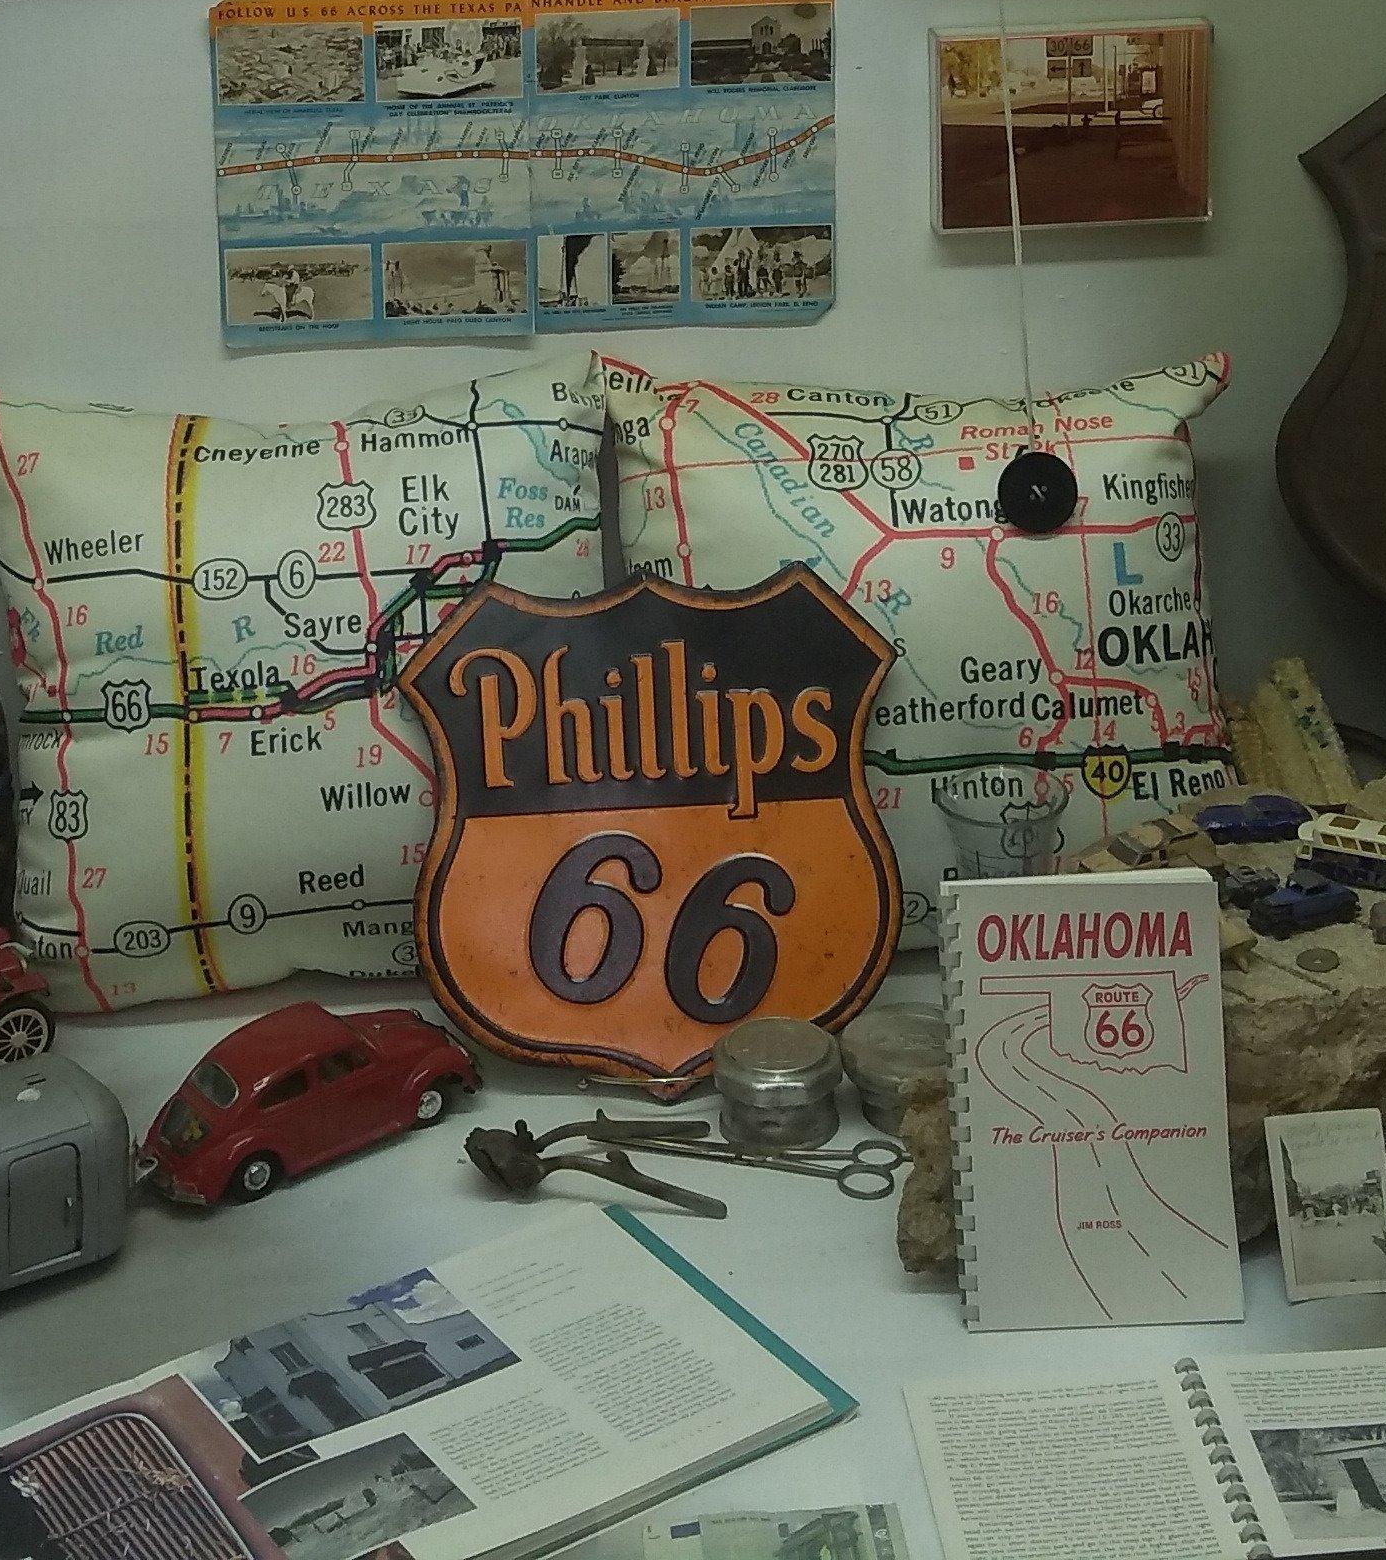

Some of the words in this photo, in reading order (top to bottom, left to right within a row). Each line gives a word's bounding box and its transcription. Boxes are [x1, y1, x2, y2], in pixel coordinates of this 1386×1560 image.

[218, 7, 275, 20] FOLLOW
[321, 6, 339, 17] 66
[347, 4, 405, 17] ACROSS
[413, 3, 441, 14] THE
[450, 2, 495, 14] TEXAS
[749, 391, 780, 404] 28
[786, 388, 889, 407] Canton
[927, 400, 955, 421] 51
[960, 422, 1044, 440] Roman
[1054, 414, 1114, 433] Nose
[17, 452, 41, 476] 27
[816, 443, 856, 463] 270
[734, 419, 836, 541] Canadian
[818, 463, 858, 483] 281
[877, 453, 914, 483] 58
[402, 474, 450, 503] Elk
[498, 476, 548, 500] Foss
[644, 487, 667, 511] 13
[327, 493, 367, 518] 283
[555, 495, 581, 512] DAM
[398, 507, 460, 540] City
[505, 507, 545, 529] Res
[44, 529, 144, 567] Wheeler
[1159, 524, 1181, 550] 33
[318, 542, 346, 564] 22
[406, 543, 431, 565] 17
[940, 546, 956, 569] 9
[1112, 541, 1145, 587] L
[201, 568, 239, 592] 152
[288, 564, 305, 589] 6
[863, 579, 891, 604] 13
[1032, 591, 1060, 615] 16
[1107, 586, 1192, 617] Okarche
[65, 605, 89, 627] 16
[232, 613, 257, 643] R
[283, 610, 362, 646] Sayre
[95, 624, 144, 655] Red
[190, 660, 282, 693] Texola
[291, 654, 316, 677] 16
[960, 655, 1043, 684] Geary
[112, 695, 142, 722] 66
[323, 709, 337, 731] 5
[874, 691, 1025, 728] eatherford
[1031, 689, 1145, 722] Calumet
[250, 726, 323, 757] Erick
[450, 639, 838, 820] Phillips
[1017, 726, 1034, 749] 6
[144, 732, 170, 756] 15
[218, 731, 233, 754] 7
[355, 745, 384, 769] 19
[1090, 760, 1125, 784] 40
[1132, 771, 1160, 801] El
[1168, 767, 1226, 798] Reno
[320, 783, 411, 812] Willow
[875, 787, 903, 810] 21
[930, 771, 1024, 804] Hinton
[54, 803, 82, 833] 83
[401, 843, 427, 865] 15
[82, 868, 106, 890] 27
[299, 864, 365, 894] Reed
[239, 904, 256, 928] 9
[529, 830, 797, 1025] 66
[123, 930, 161, 950] 203
[977, 910, 1194, 963] OKLAHOMA
[1095, 990, 1141, 1005] ROUTE
[1095, 1009, 1146, 1049] 66
[991, 1126, 1024, 1145] The
[1029, 1124, 1106, 1144] Cruiser's
[1112, 1122, 1208, 1144] Companion
[1077, 1221, 1095, 1231] JIM
[1096, 1219, 1123, 1230] ROSS
